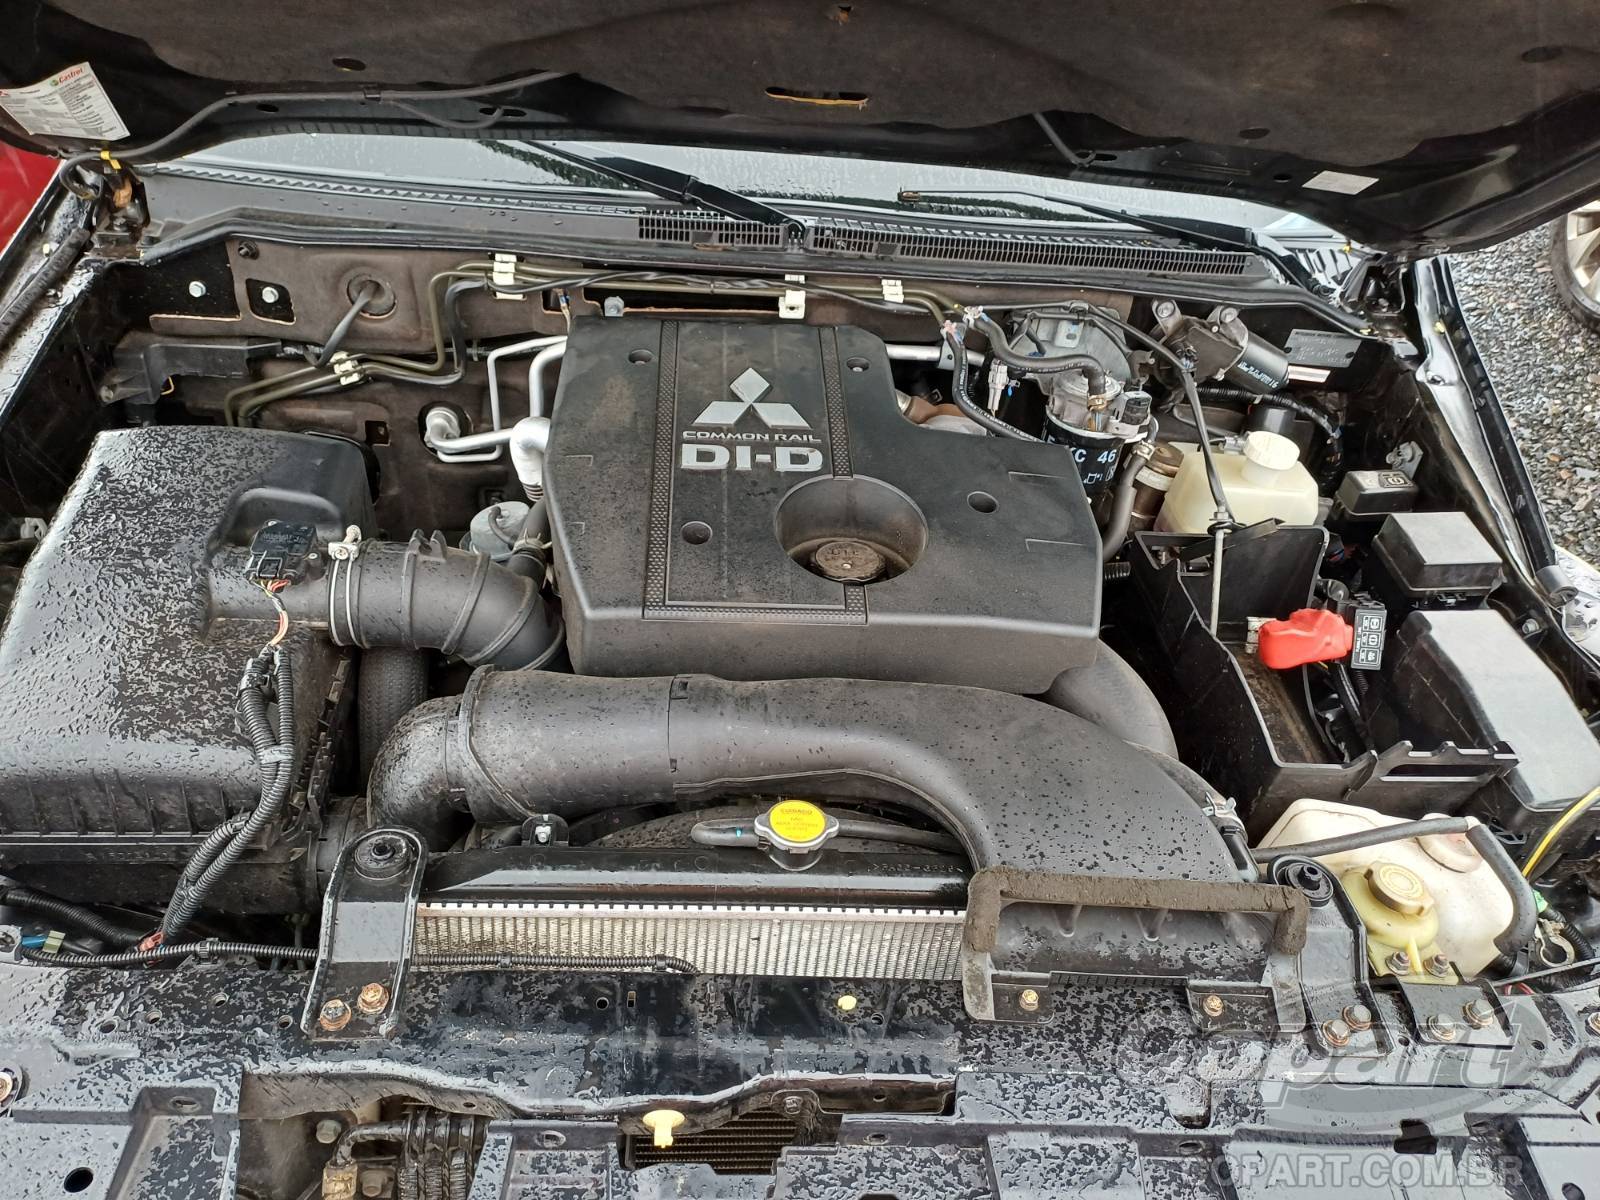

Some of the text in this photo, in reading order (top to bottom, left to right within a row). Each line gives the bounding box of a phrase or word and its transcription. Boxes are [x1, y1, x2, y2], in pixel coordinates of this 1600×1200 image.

[58, 67, 83, 83] Castrol
[682, 430, 822, 443] COMMON RAIL
[680, 443, 823, 472] DI-D
[1070, 447, 1117, 464] C 46
